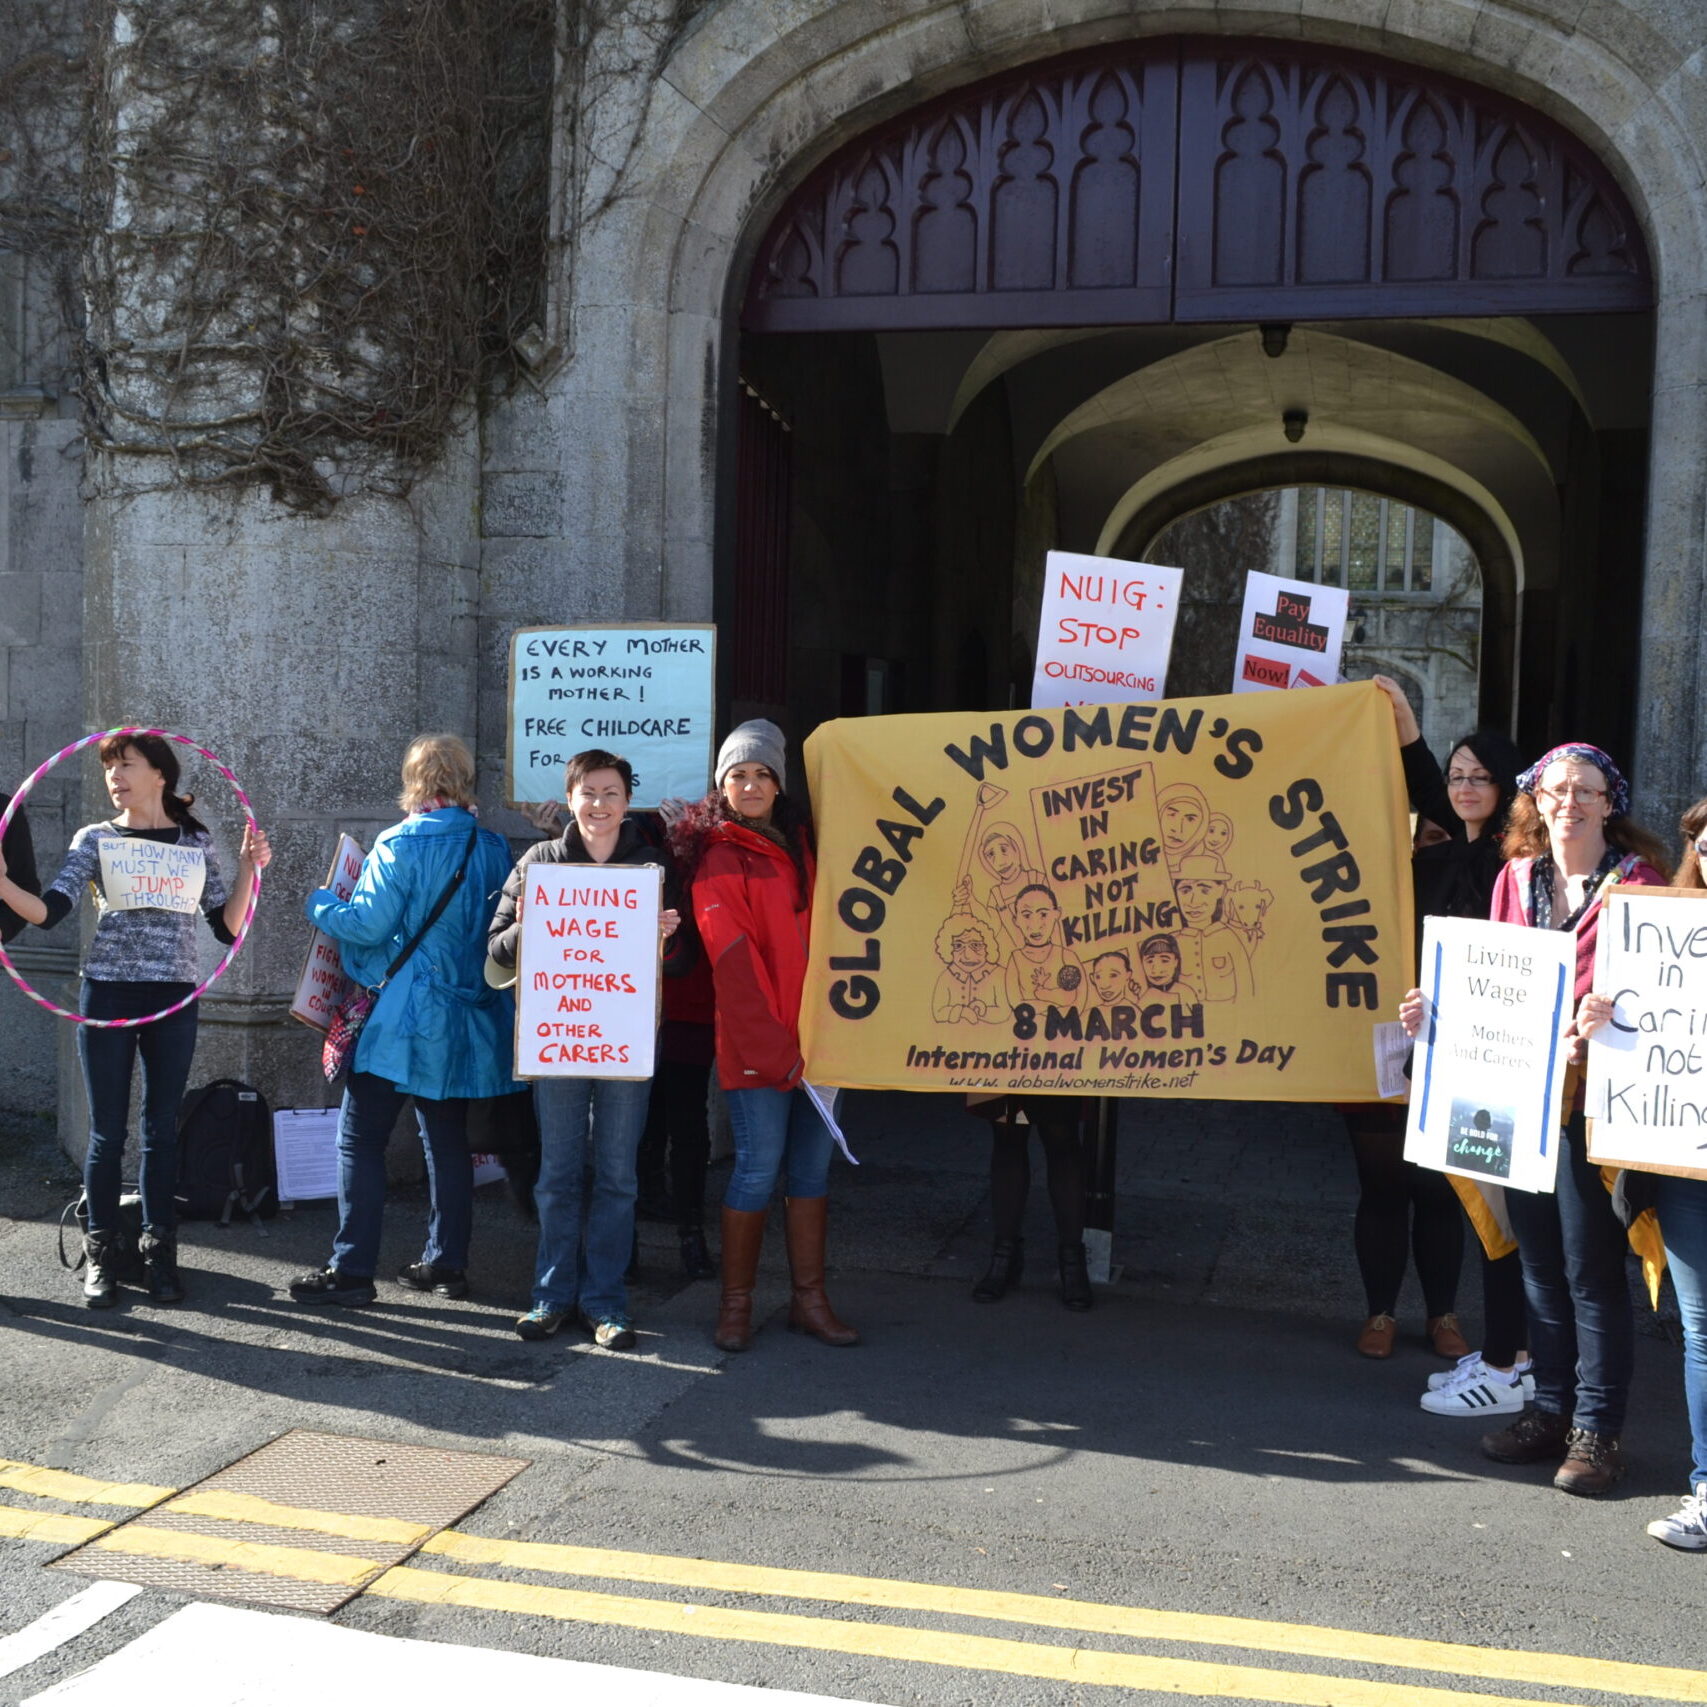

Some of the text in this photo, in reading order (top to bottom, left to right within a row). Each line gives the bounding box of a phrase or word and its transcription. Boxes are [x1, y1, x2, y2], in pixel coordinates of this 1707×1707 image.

[1060, 571, 1164, 611] NUIG:
[1277, 596, 1310, 622] Pay
[1058, 618, 1140, 650] STOP
[1254, 617, 1327, 651] Equality
[526, 638, 705, 658] EVERY MOTHER
[522, 666, 652, 681] IS A WORKING
[1045, 661, 1155, 692] OUTSOURCING
[1244, 660, 1289, 685] Now!
[525, 718, 691, 737] FREE CHILDCARE
[530, 750, 566, 768] FOR
[1042, 769, 1142, 817] INVEST
[1079, 810, 1109, 841] IN
[102, 842, 202, 865] BUT HOW MANY
[829, 705, 1379, 1020] GLOBAL WOMEN'S STRIKE
[1051, 837, 1161, 882] CARING
[111, 860, 190, 877] MUST WE
[131, 876, 184, 897] JUMP
[535, 885, 637, 910] A LIVING
[1085, 872, 1139, 910] NOT
[120, 893, 196, 909] THROUGH?
[546, 918, 619, 939] WAGE
[1062, 901, 1179, 947] KILLING
[316, 944, 341, 969] FIGH
[564, 949, 604, 963] FOR
[1467, 944, 1534, 977] Living
[534, 971, 637, 993] MOTHERS
[1659, 961, 1684, 988] in
[557, 995, 592, 1012] AND
[1467, 976, 1528, 1007] Wage
[537, 1022, 603, 1038] OTHER
[1013, 1003, 1204, 1041] 8 MARCH
[1472, 1025, 1534, 1047] Mothers
[538, 1043, 630, 1063] CARERS
[906, 1039, 1296, 1071] International Women's Day
[1449, 1042, 1531, 1070] And Carers
[1646, 1043, 1702, 1076] not
[1453, 1138, 1503, 1164] change
